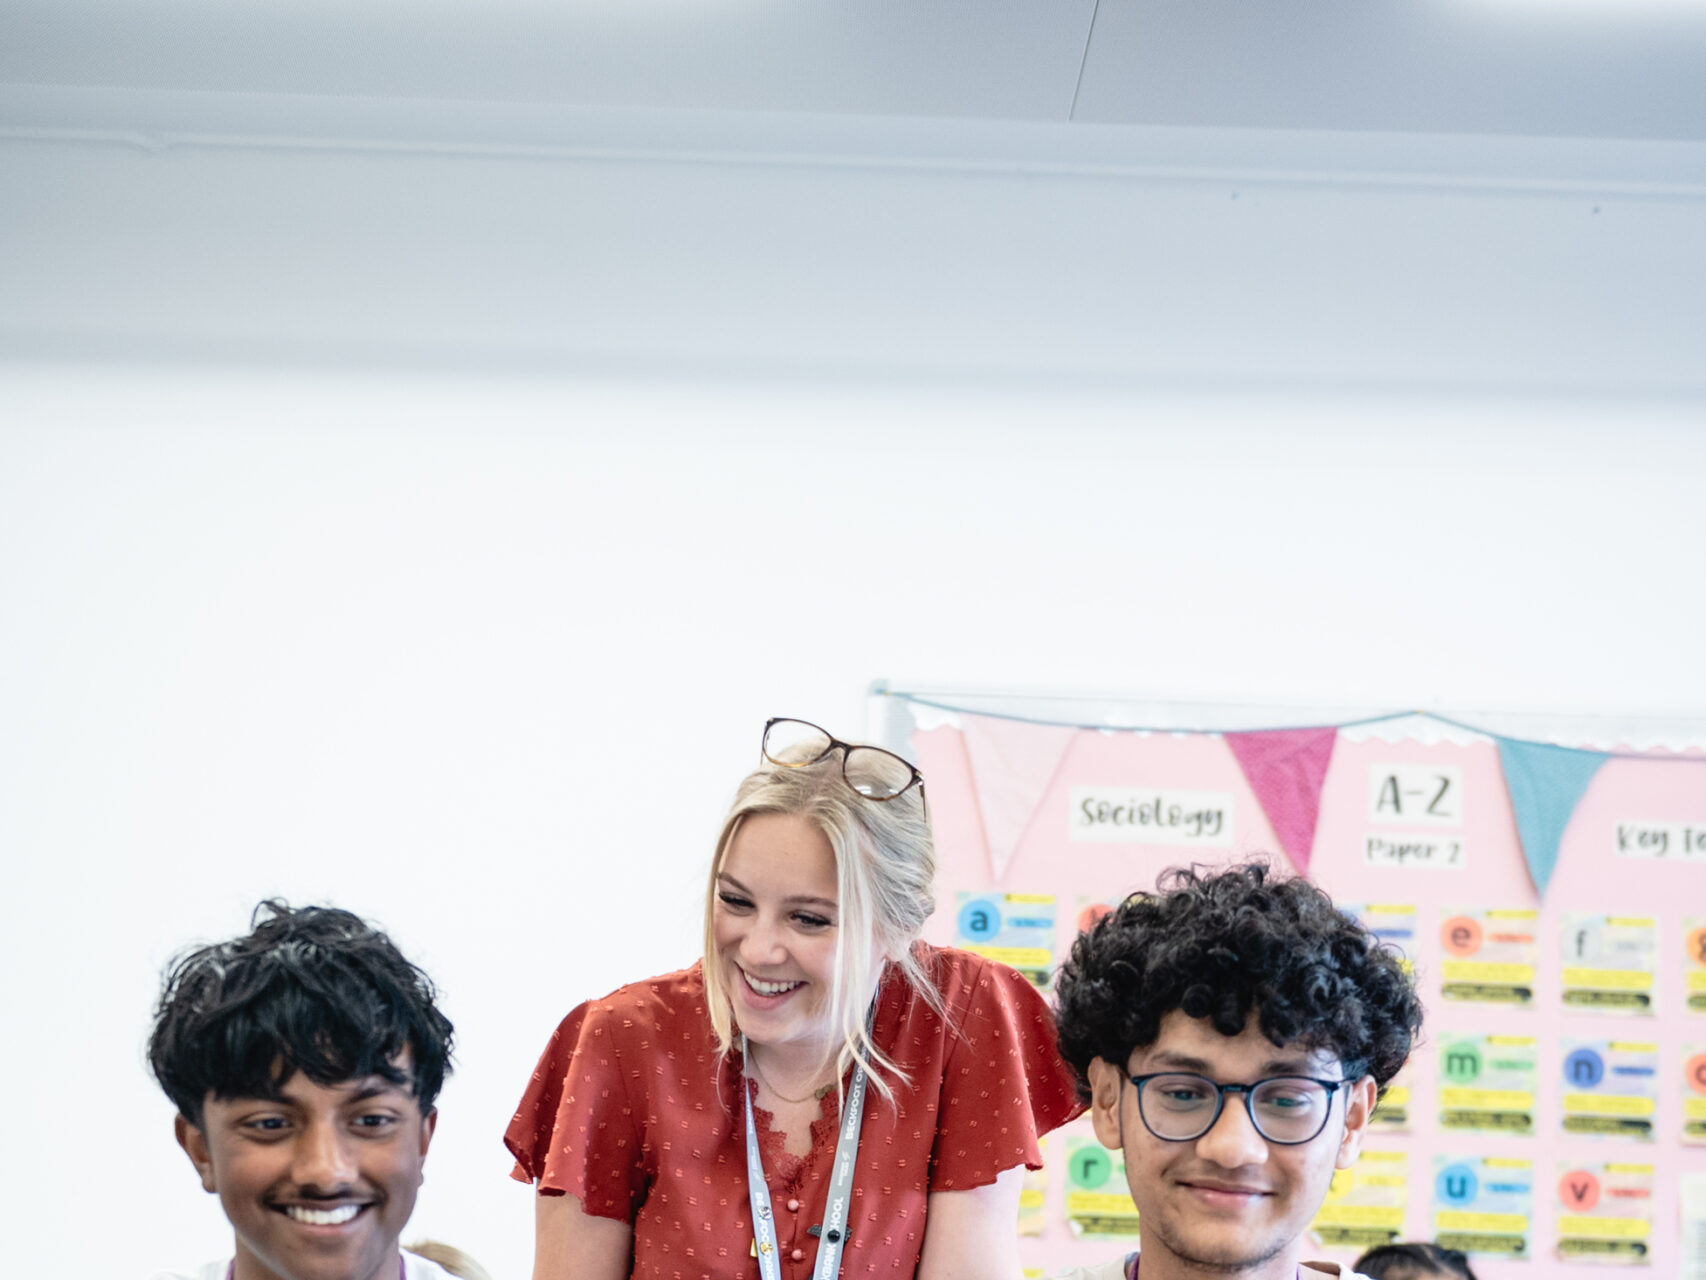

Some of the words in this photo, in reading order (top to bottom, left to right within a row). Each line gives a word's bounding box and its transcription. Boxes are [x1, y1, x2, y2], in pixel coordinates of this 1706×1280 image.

[1376, 773, 1453, 817] A-Z
[1080, 797, 1223, 837] Sociology
[1366, 838, 1438, 864] Paper
[1447, 841, 1461, 863] 2
[1617, 825, 1669, 858] Key
[969, 910, 988, 932] a
[1451, 926, 1471, 948] e
[1574, 929, 1587, 957] f
[1446, 1052, 1478, 1075] m
[1573, 1058, 1594, 1081] n
[845, 1084, 862, 1140] BECKFOOT
[1083, 1159, 1098, 1180] r
[1446, 1178, 1466, 1198] u
[1570, 1182, 1588, 1202] v
